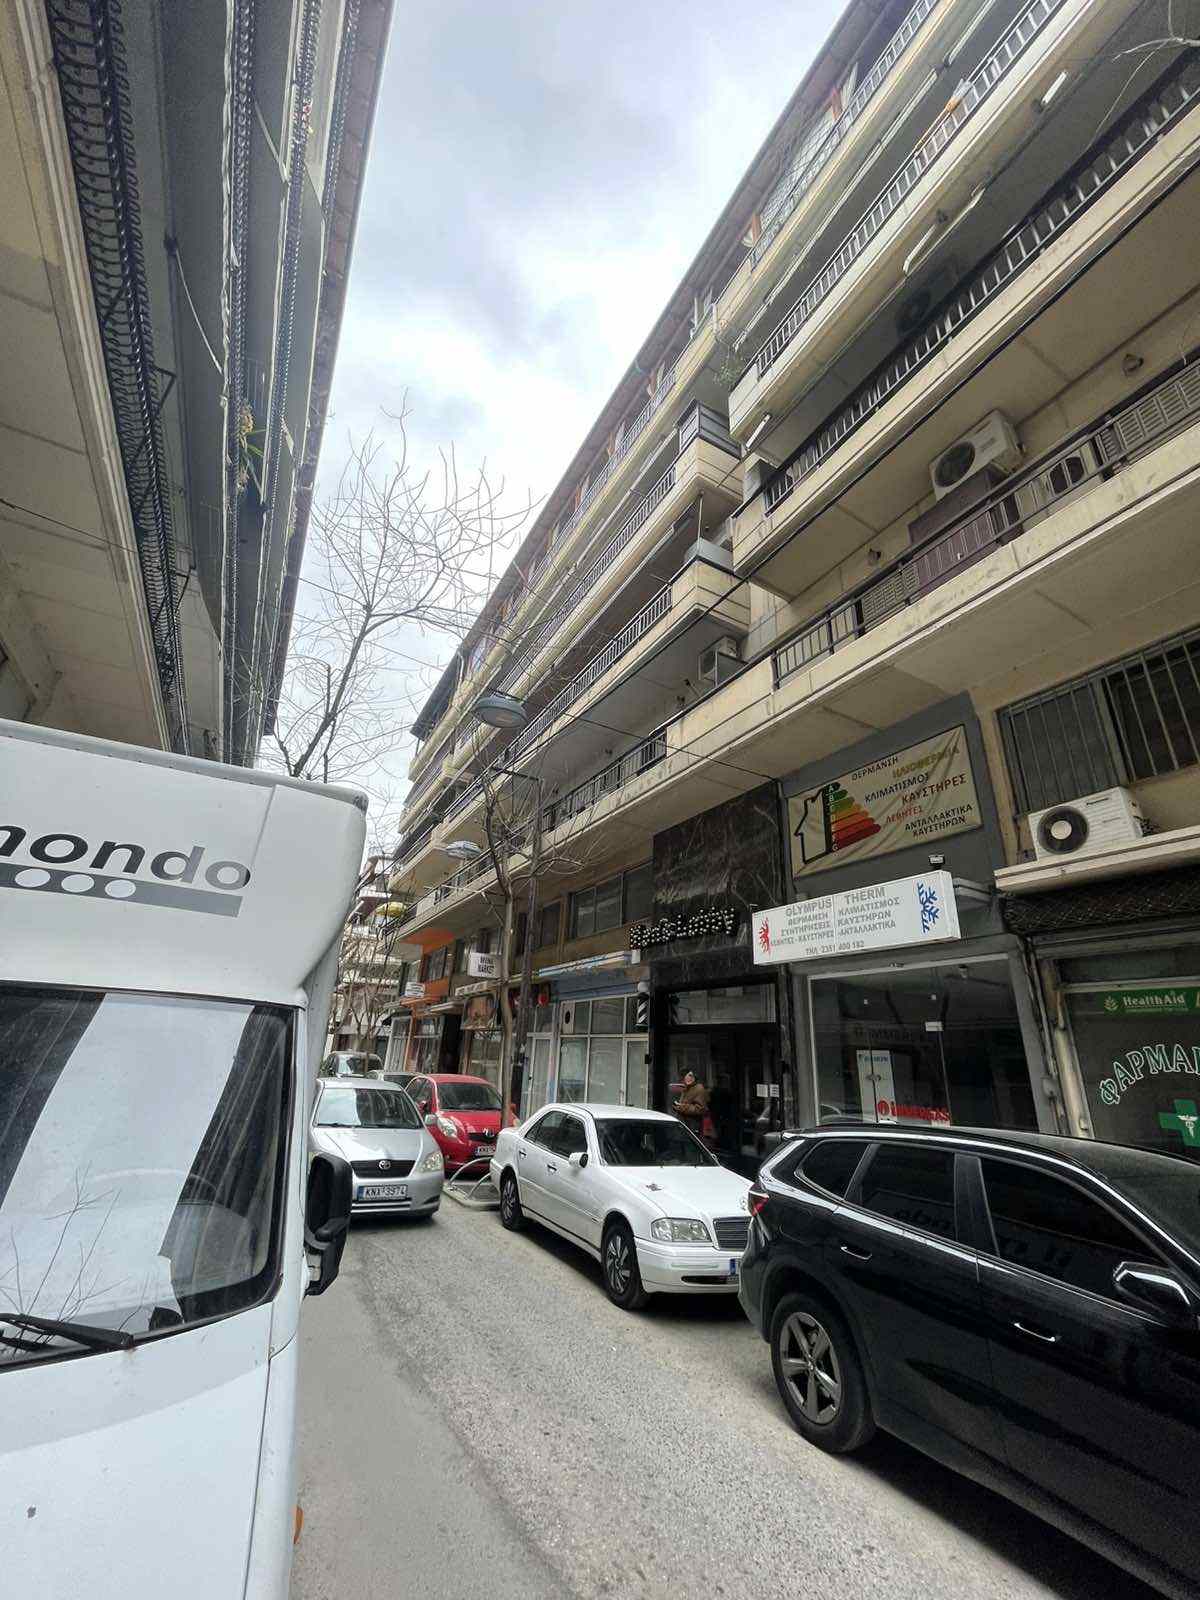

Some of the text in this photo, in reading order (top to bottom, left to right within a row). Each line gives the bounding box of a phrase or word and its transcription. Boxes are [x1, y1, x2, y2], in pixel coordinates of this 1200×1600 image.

[851, 756, 898, 781] ΘΕΡΜΑΝΣΗ
[864, 772, 929, 802] ΚΛΙΜΑΤΙΣΜΟΣ
[902, 773, 967, 805] ΚΑΥΣΤΗΡΕΣ
[905, 803, 973, 831] ΑΝΤΑΛΛΑΚΤΙΚΑ
[912, 815, 967, 838] ΚΑΥΣΤΗΡΩΝ
[785, 887, 886, 917] OLYMPUS THERM
[838, 896, 900, 916] ΚΛΙΜΑΤΙΣΜΟΣ
[837, 910, 892, 927] ΚΑΥΣΤΗΡΩΝ
[1122, 994, 1185, 1006] HealthAid
